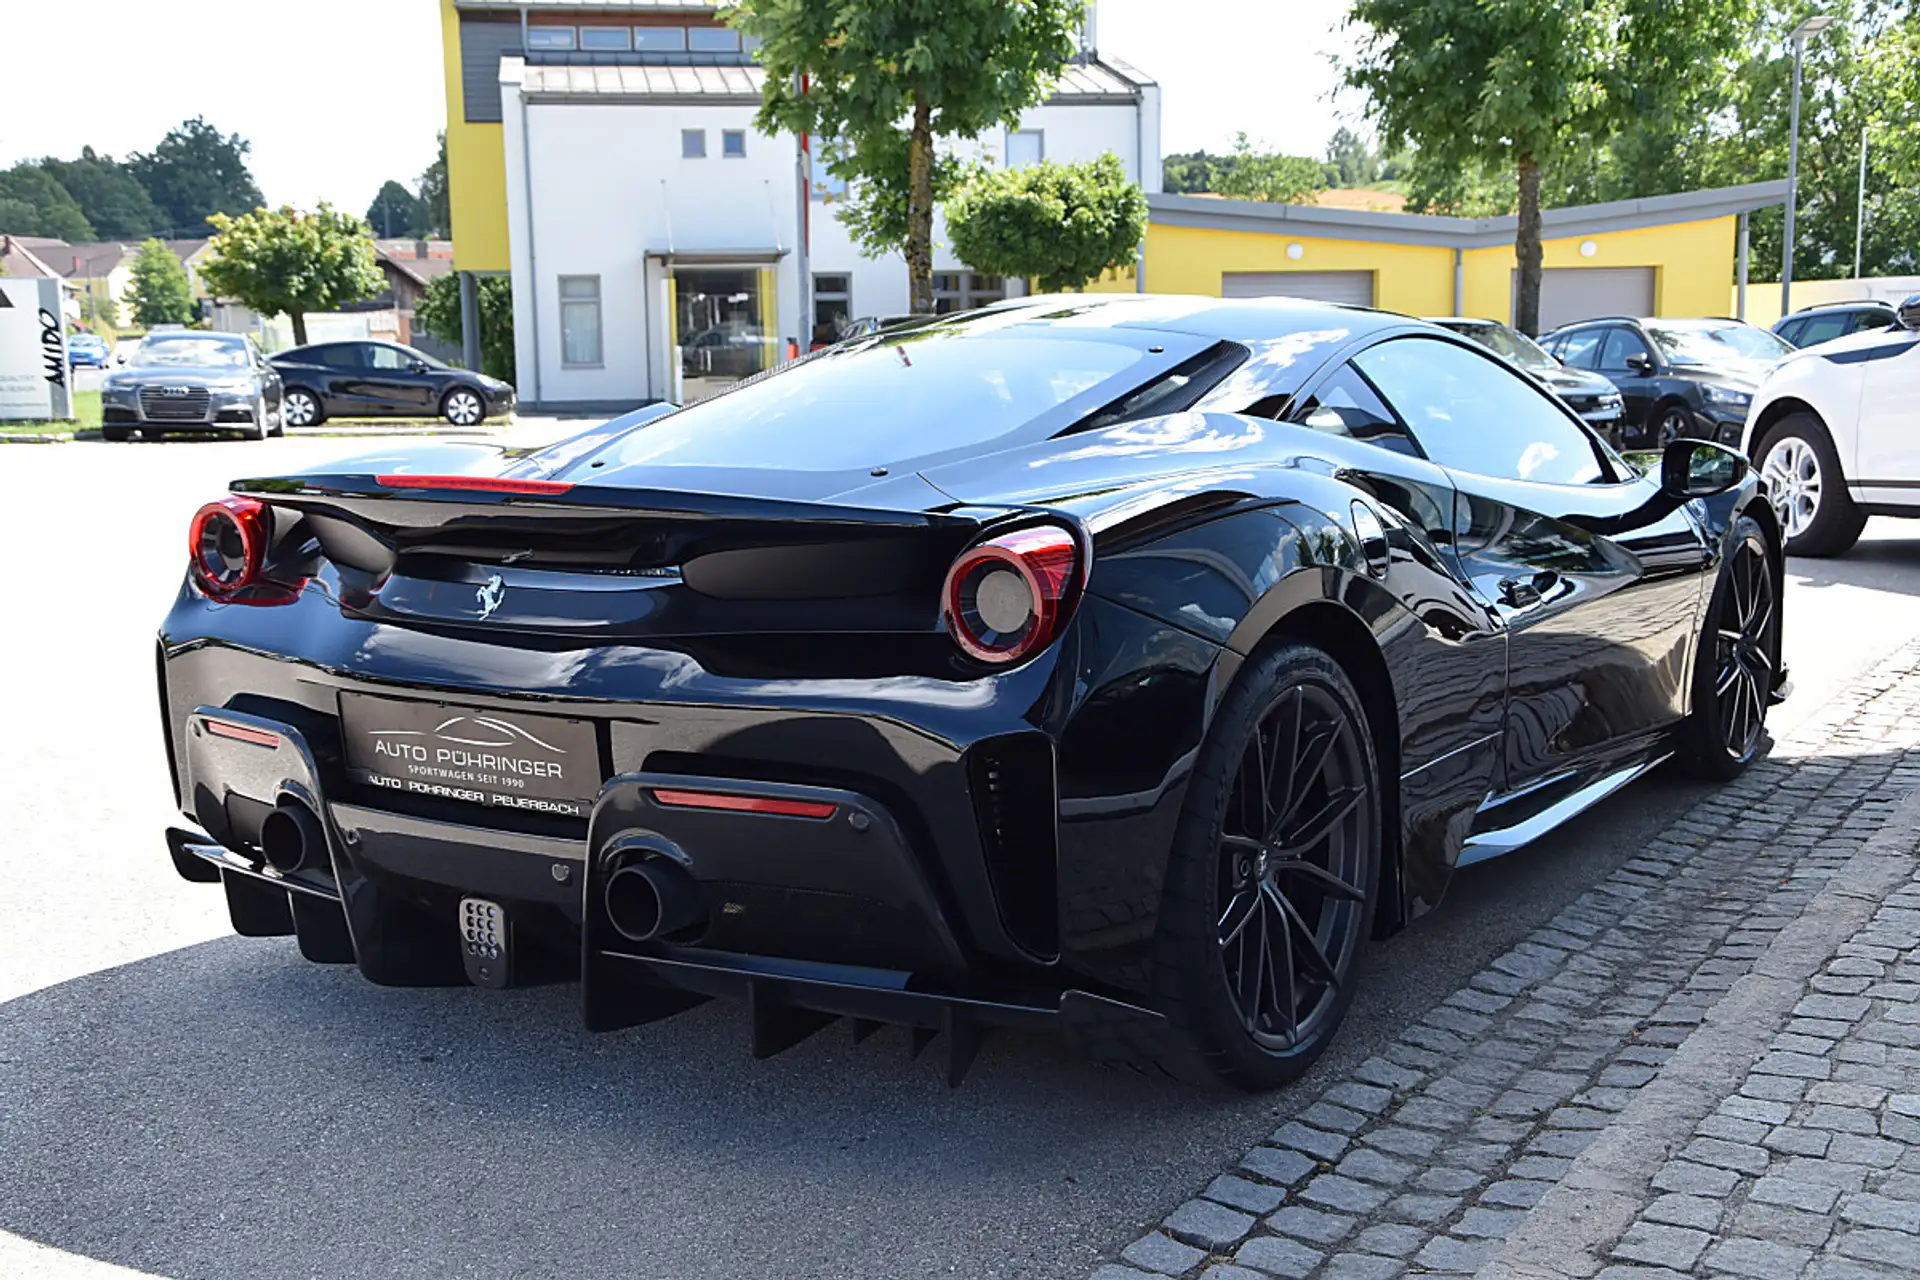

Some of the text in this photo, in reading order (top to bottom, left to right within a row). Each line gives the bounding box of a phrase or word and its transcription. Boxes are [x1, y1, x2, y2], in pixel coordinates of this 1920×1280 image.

[38, 307, 65, 388] AMIDO
[375, 740, 563, 778] AUTO PÜHRINGER
[408, 765, 525, 788] SPORTWAGEN SEIT 1990
[368, 775, 402, 789] AUTO
[492, 794, 580, 815] PEUERBACH
